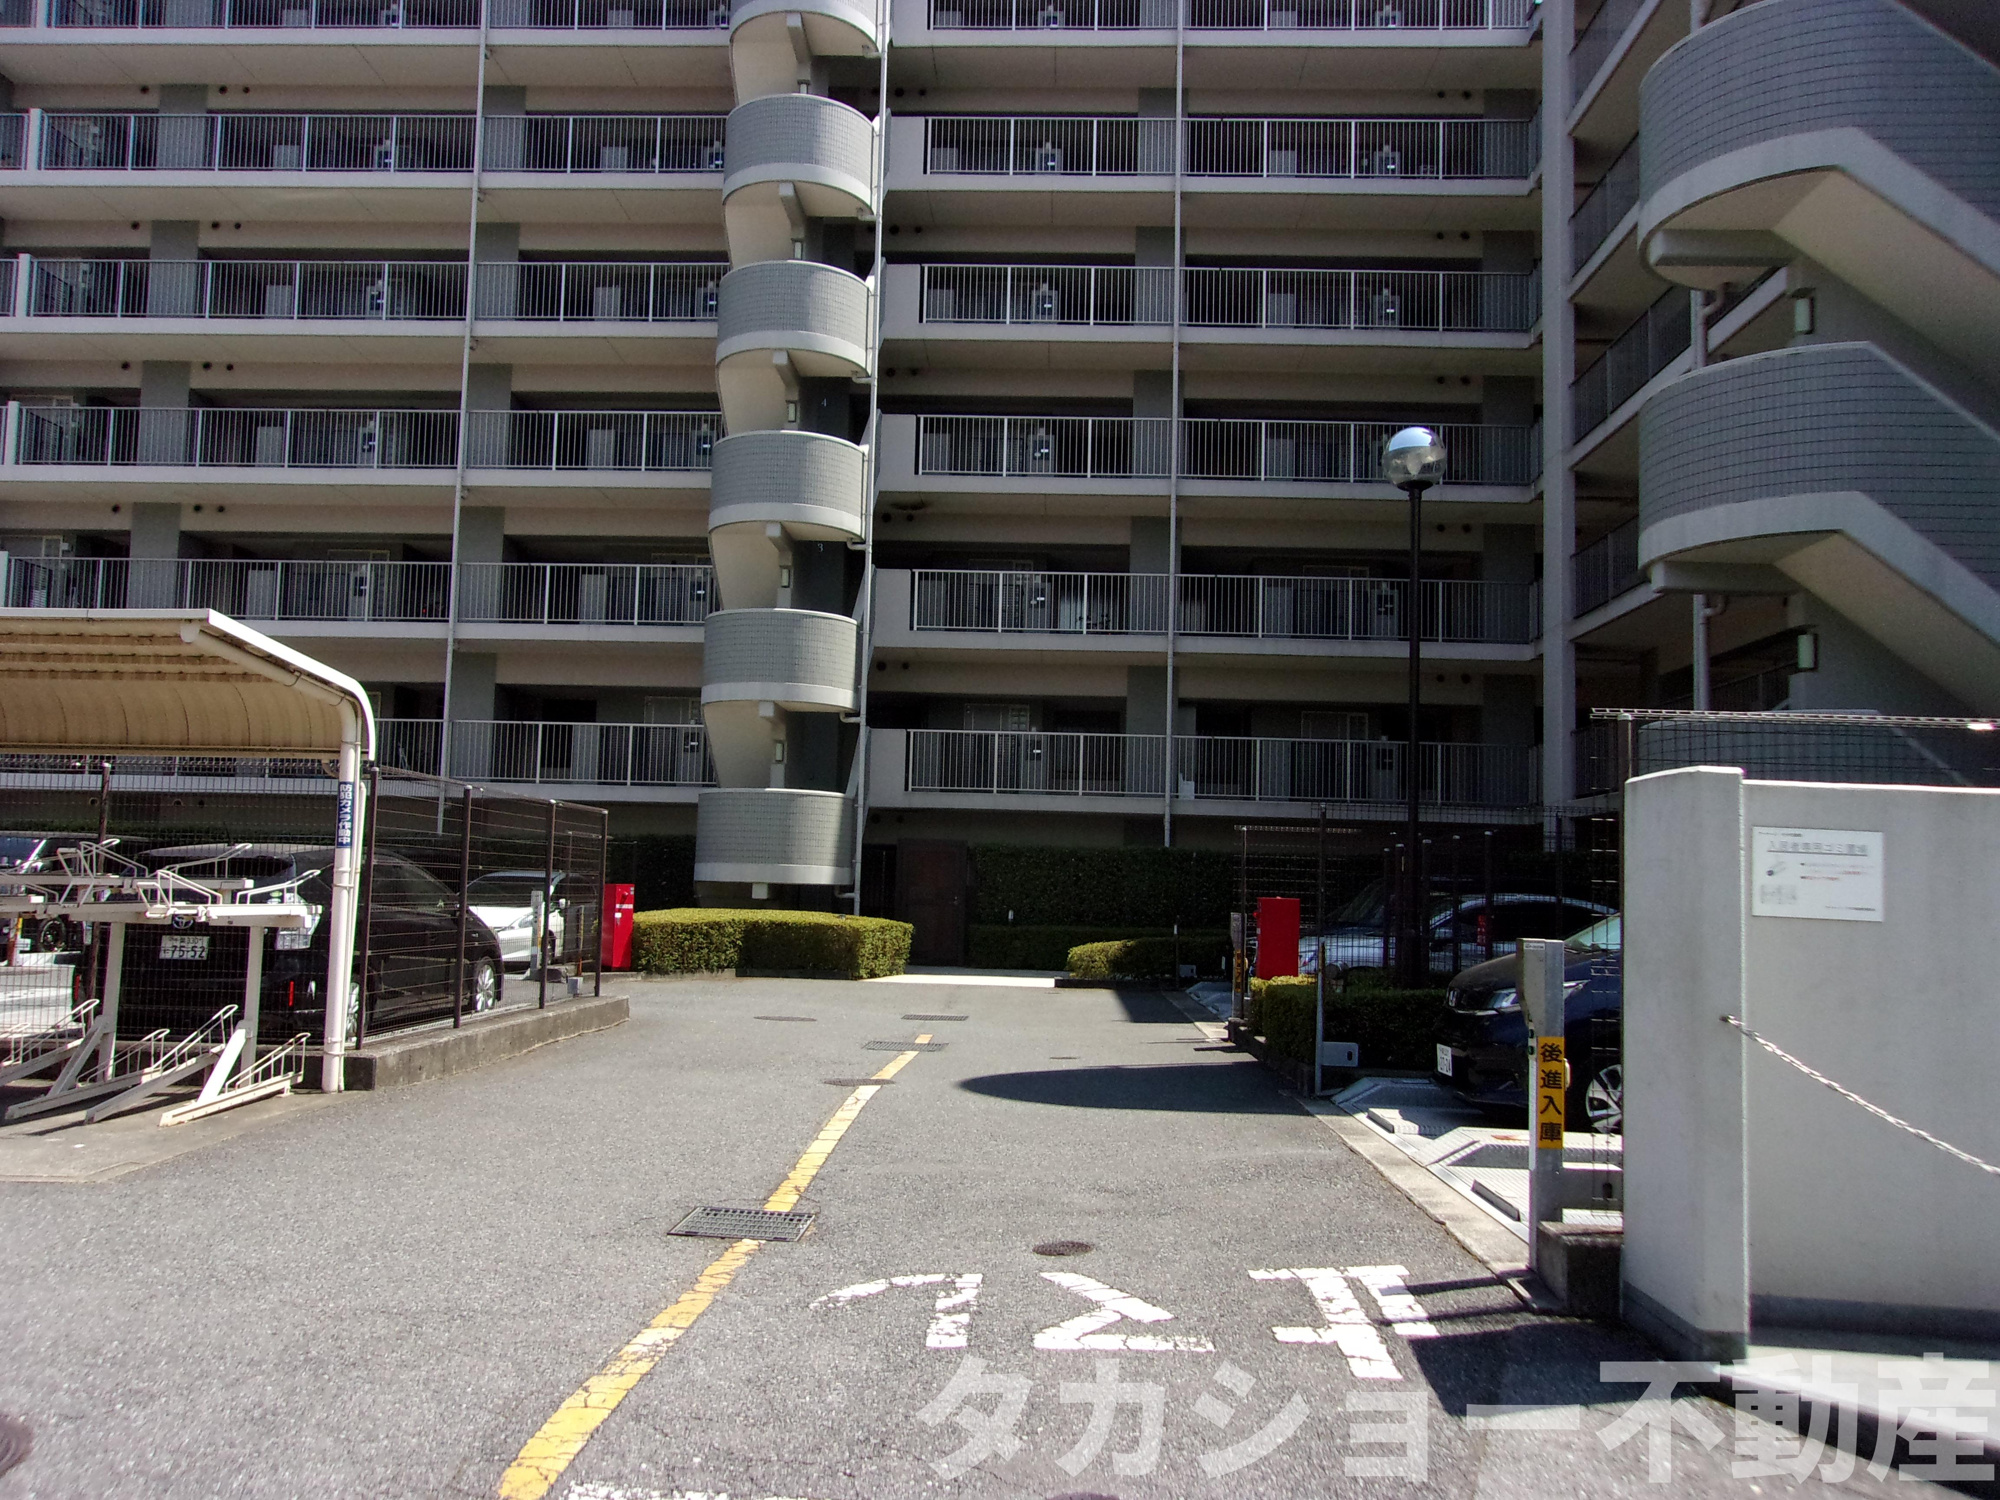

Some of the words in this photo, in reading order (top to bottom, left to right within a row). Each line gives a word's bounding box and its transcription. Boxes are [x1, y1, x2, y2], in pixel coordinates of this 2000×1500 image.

[338, 783, 353, 845] 防犯カメラ作動中
[1539, 1042, 1563, 1142] 後進入庫
